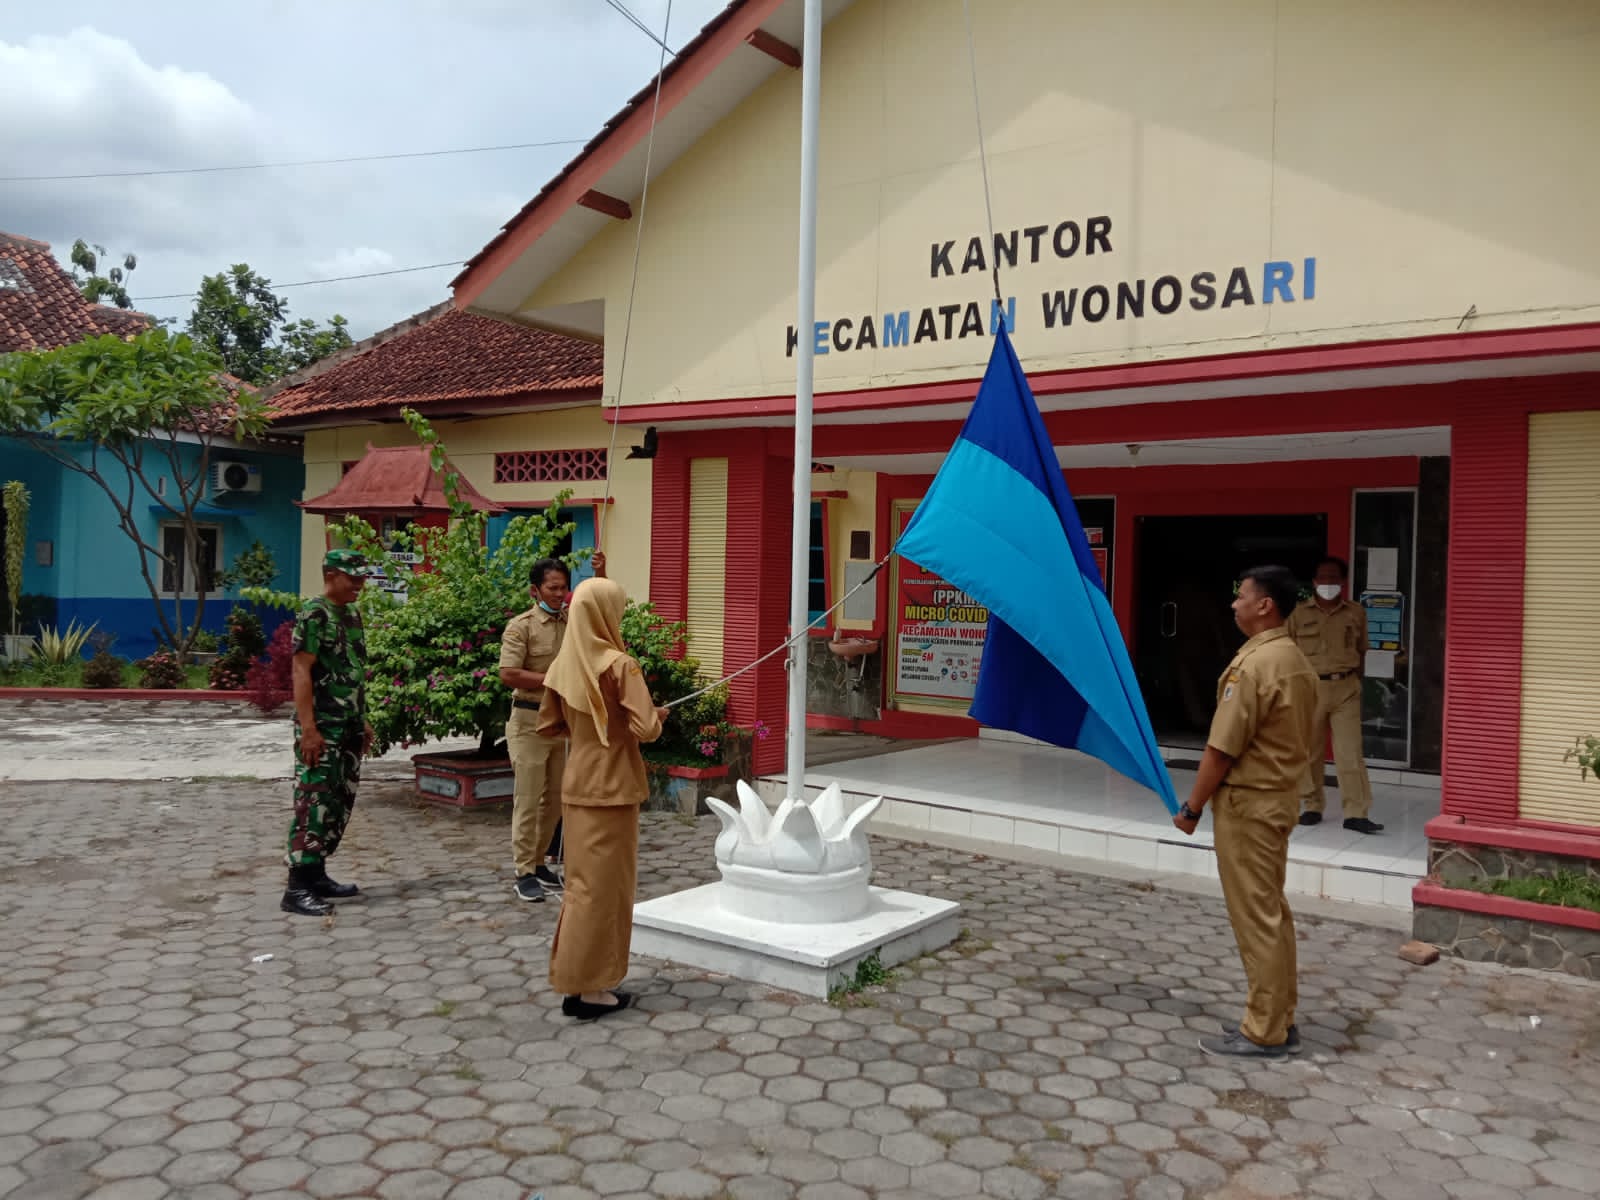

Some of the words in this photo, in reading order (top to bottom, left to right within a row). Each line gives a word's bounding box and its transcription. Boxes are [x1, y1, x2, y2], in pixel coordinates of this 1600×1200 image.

[931, 215, 1113, 278] KANTOR
[1042, 258, 1317, 328] WONOSARI
[902, 626, 957, 638] KECAMATAN
[905, 605, 945, 621] MICRO
[949, 607, 988, 623] COVID
